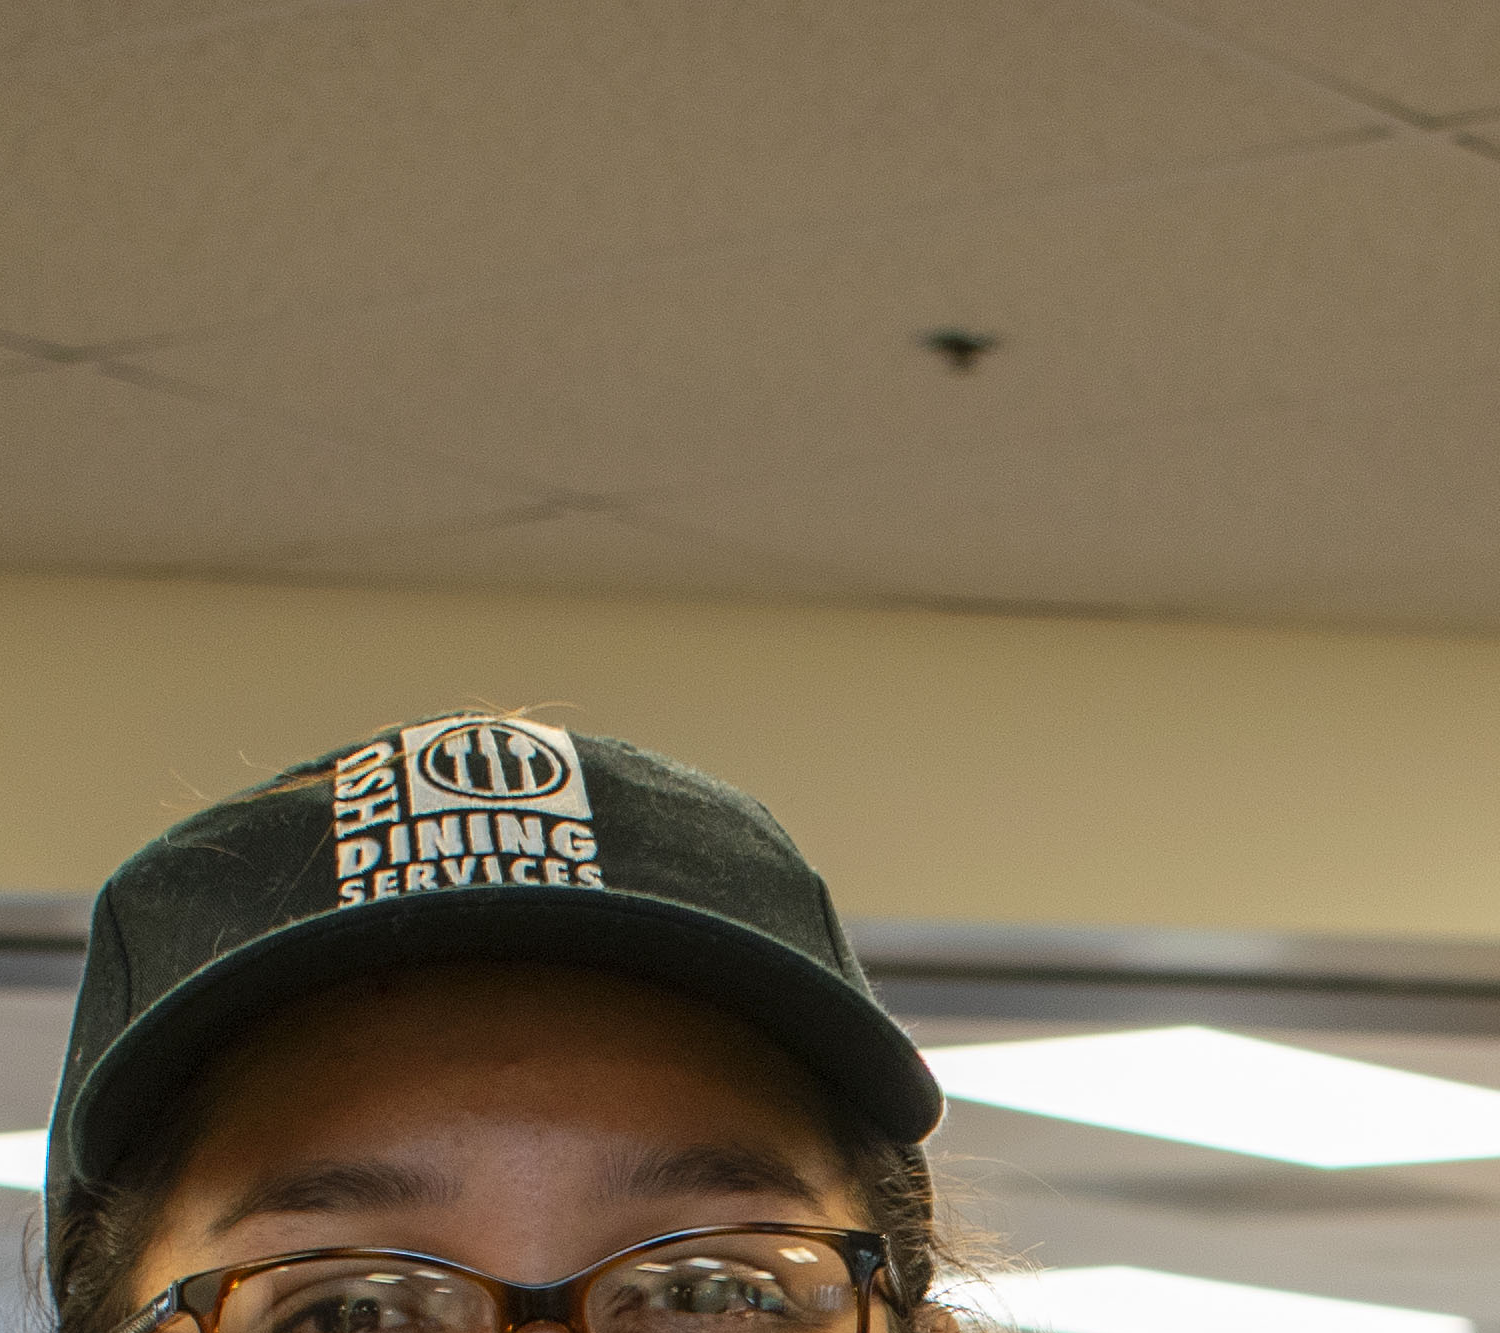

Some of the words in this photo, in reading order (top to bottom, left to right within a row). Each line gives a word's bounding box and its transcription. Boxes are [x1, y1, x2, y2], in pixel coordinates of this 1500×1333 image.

[334, 741, 399, 840] HSU
[336, 812, 598, 880] DINING
[336, 856, 604, 909] SERVICES
